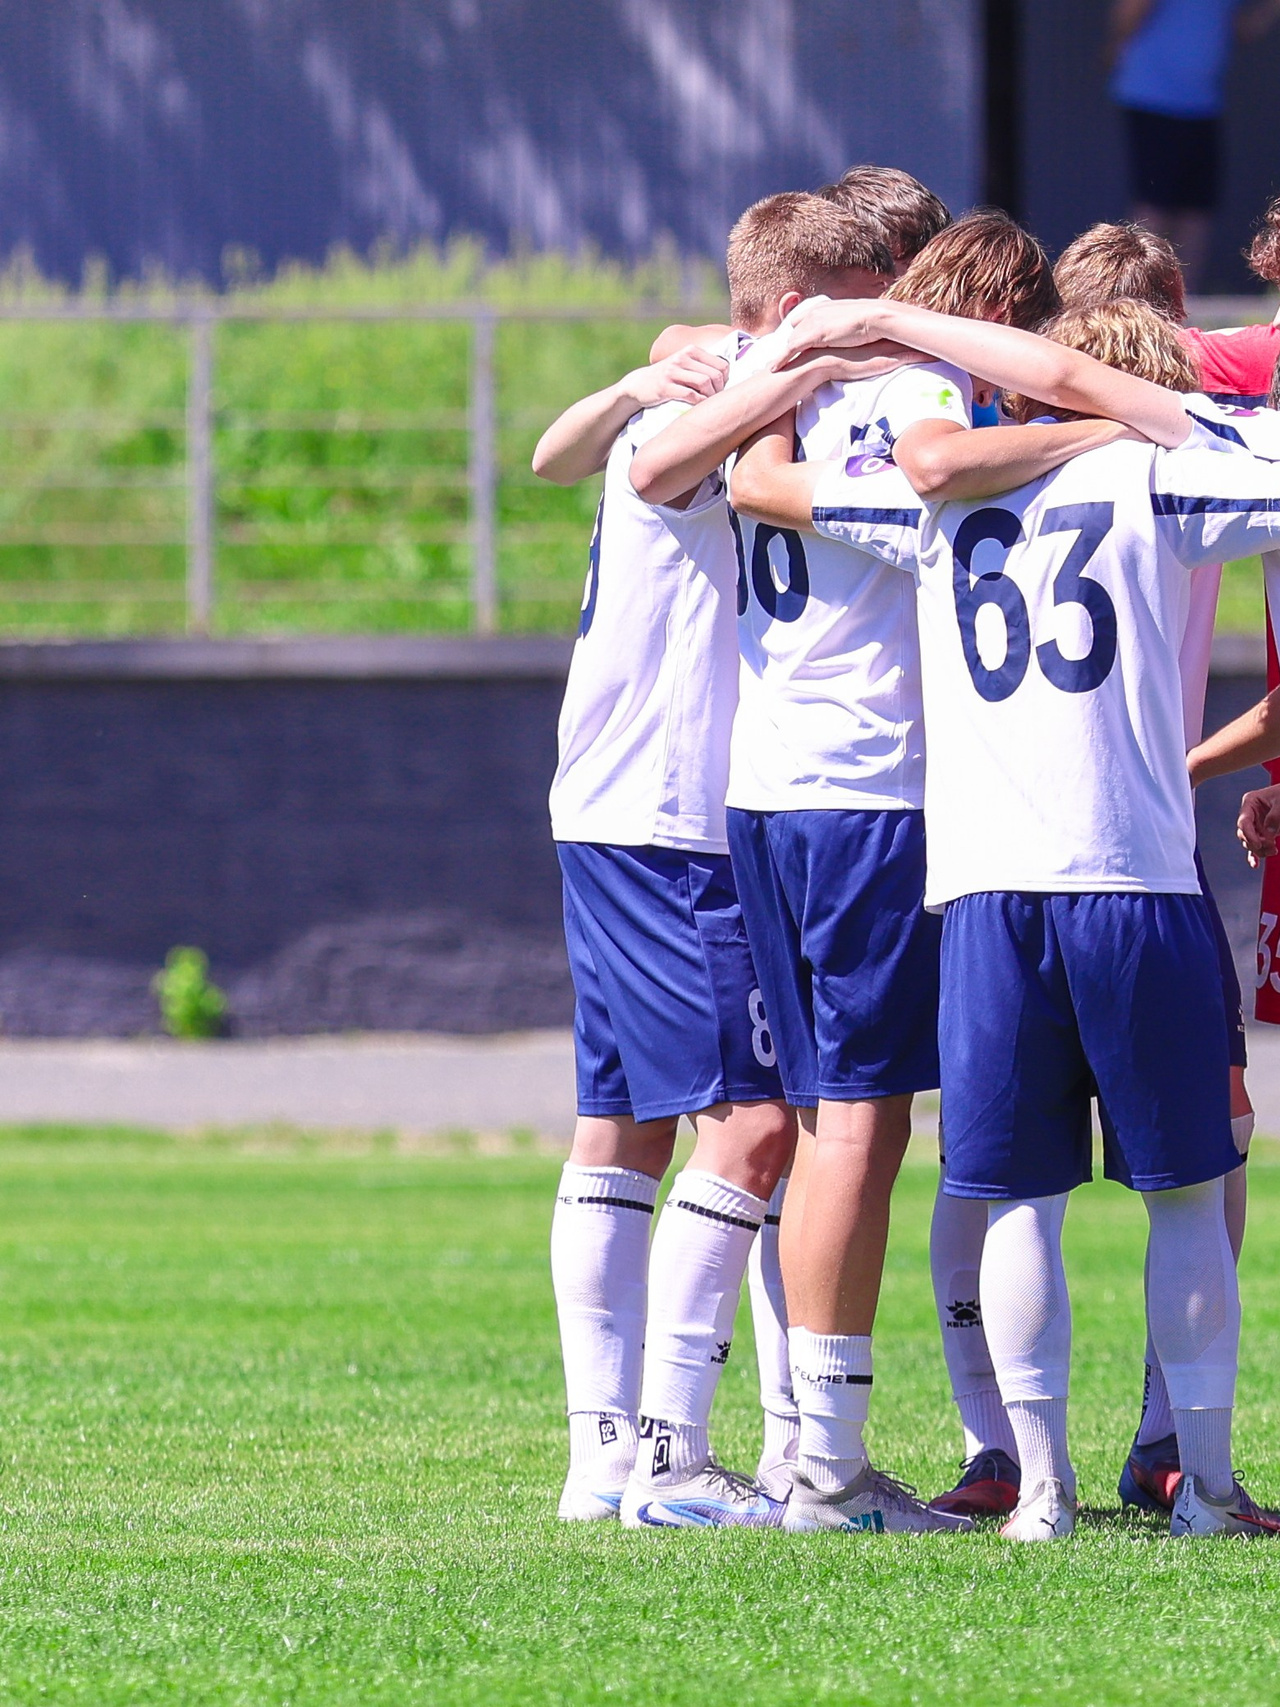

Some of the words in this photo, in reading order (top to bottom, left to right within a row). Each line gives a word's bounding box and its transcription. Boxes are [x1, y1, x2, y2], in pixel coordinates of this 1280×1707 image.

[953, 501, 1118, 702] 63
[748, 988, 777, 1067] 8
[946, 1320, 983, 1328] KELM
